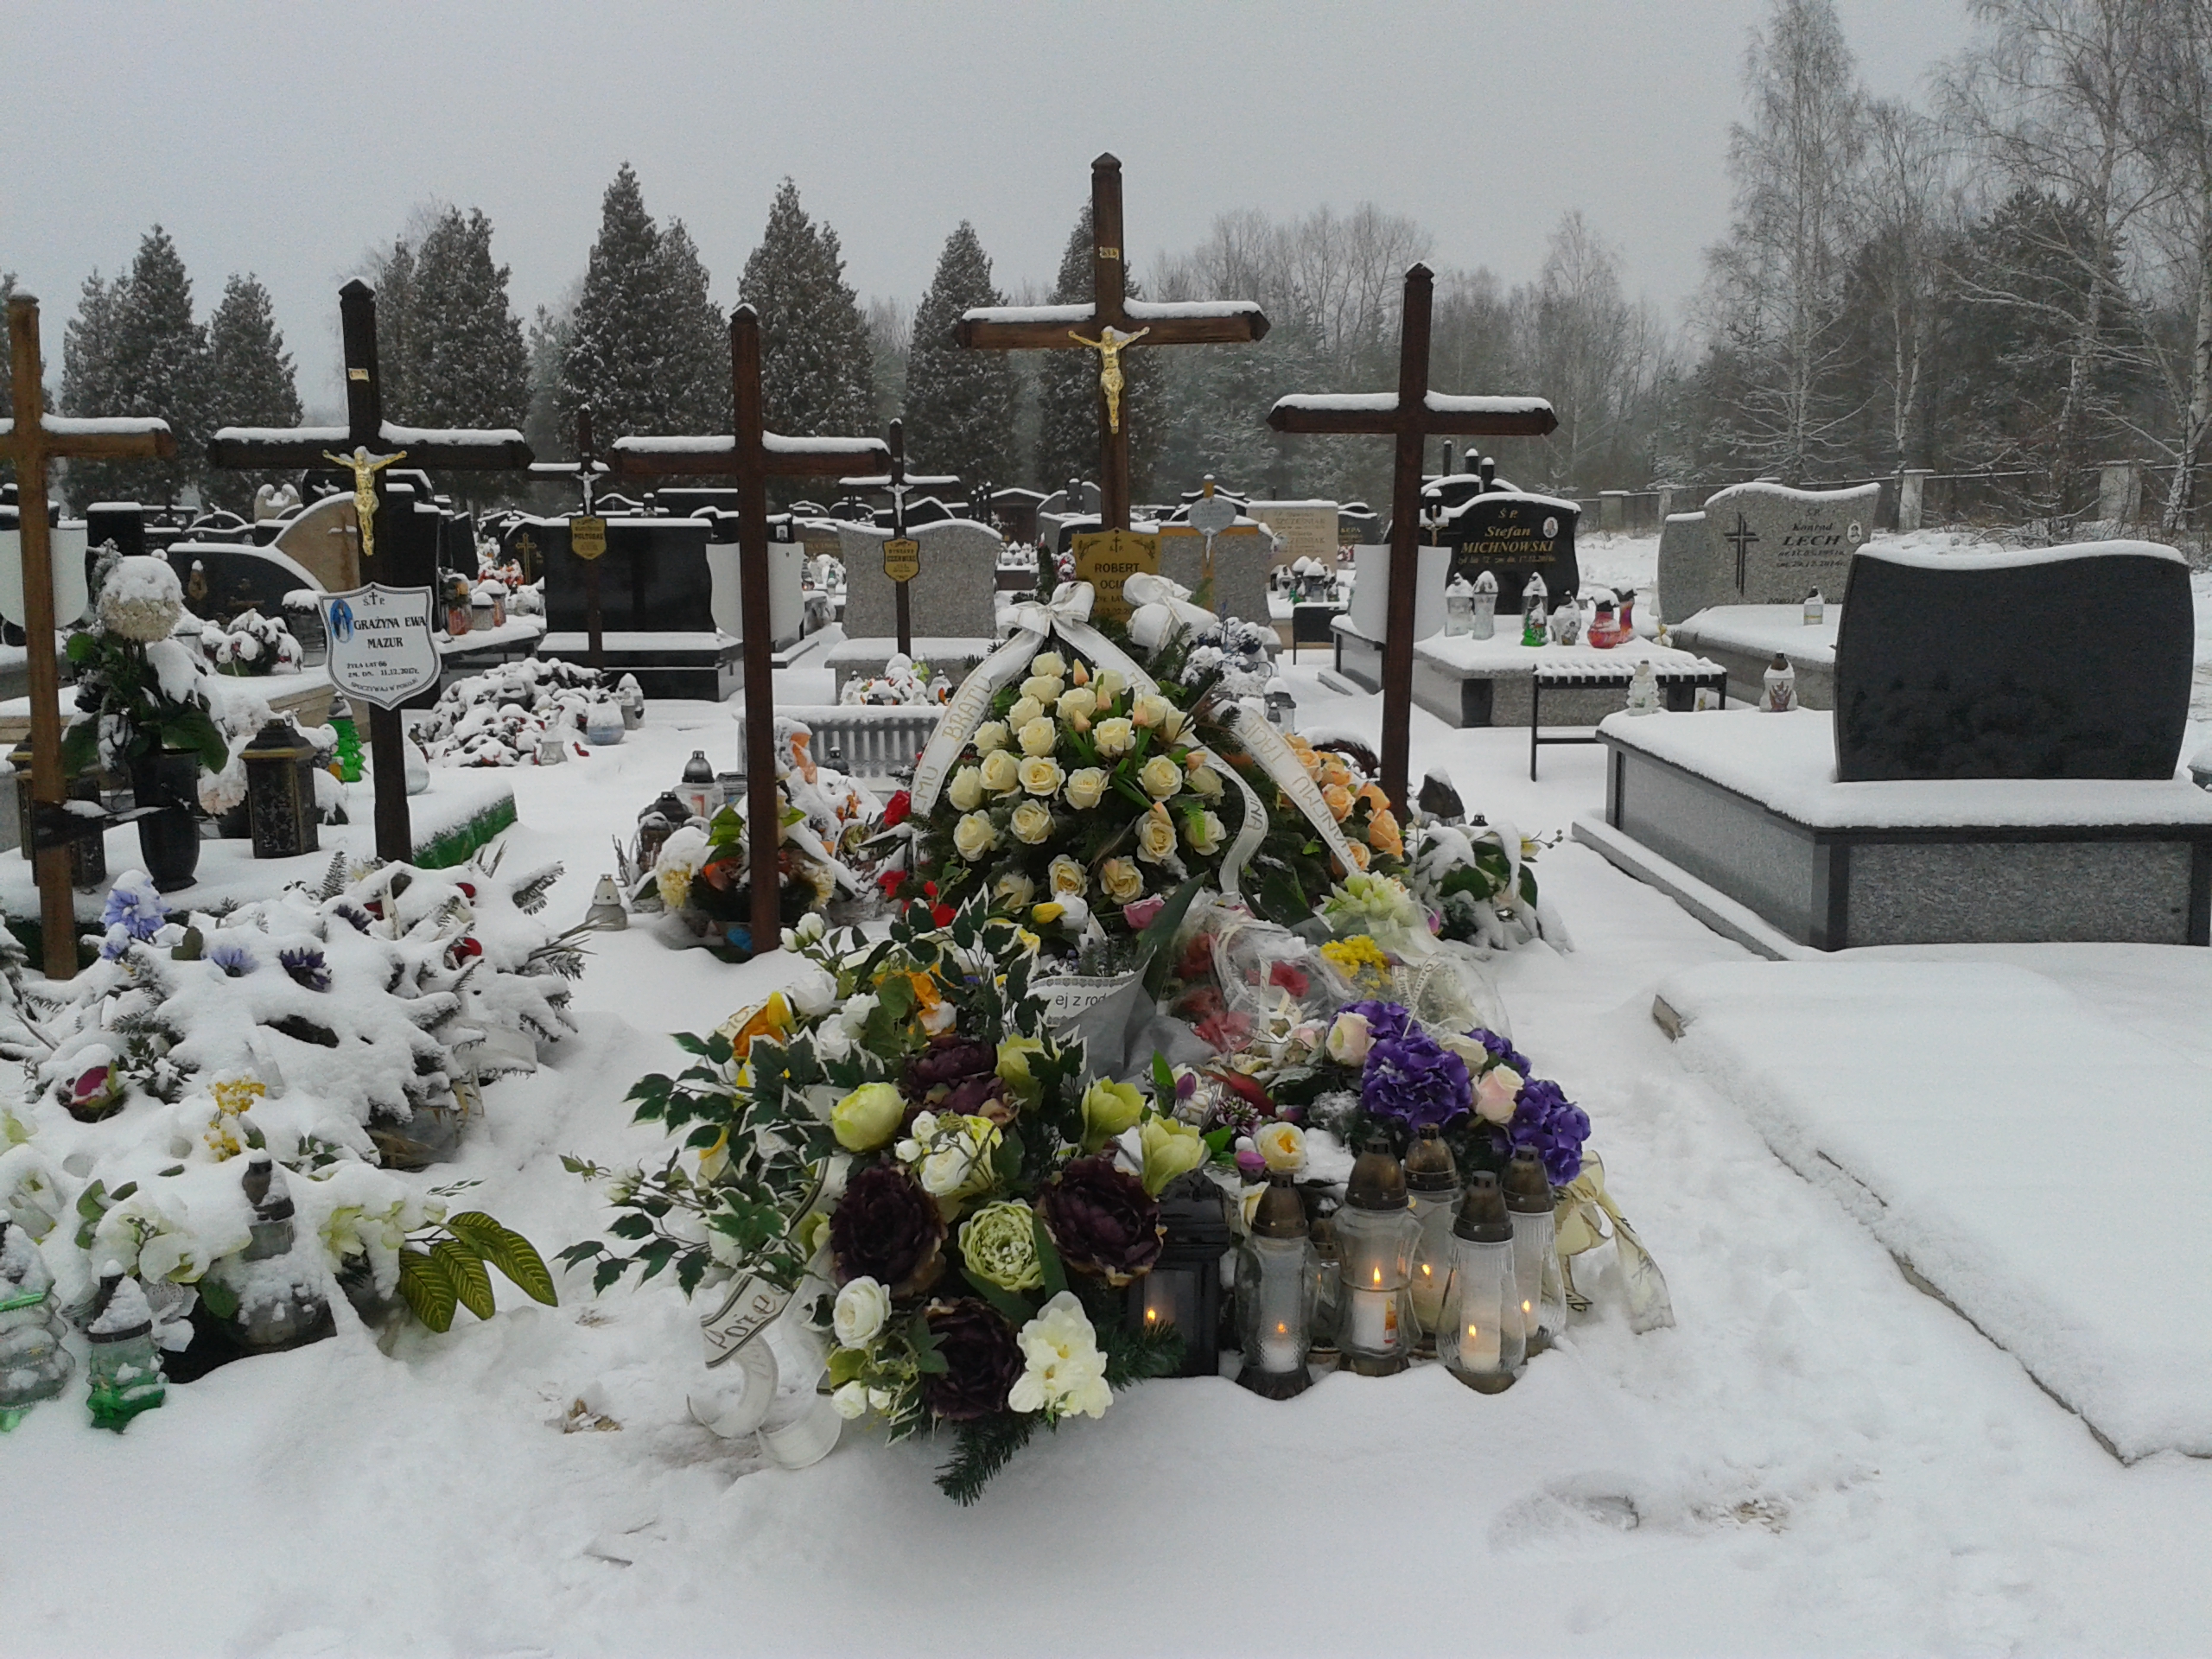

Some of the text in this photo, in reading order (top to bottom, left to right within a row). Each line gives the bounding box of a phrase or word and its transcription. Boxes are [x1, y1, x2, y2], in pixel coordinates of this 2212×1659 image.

[1484, 525, 1531, 539] Stefan
[1460, 540, 1555, 553] MICHNOWSKI
[1782, 535, 1841, 546] LECH
[1094, 563, 1140, 573] ROBERT
[353, 616, 427, 631] GRAŻYNA EWA
[367, 637, 404, 649] MAZUR
[942, 676, 993, 742] BRATU
[1238, 722, 1285, 766] TACIE
[1072, 995, 1081, 1007] z
